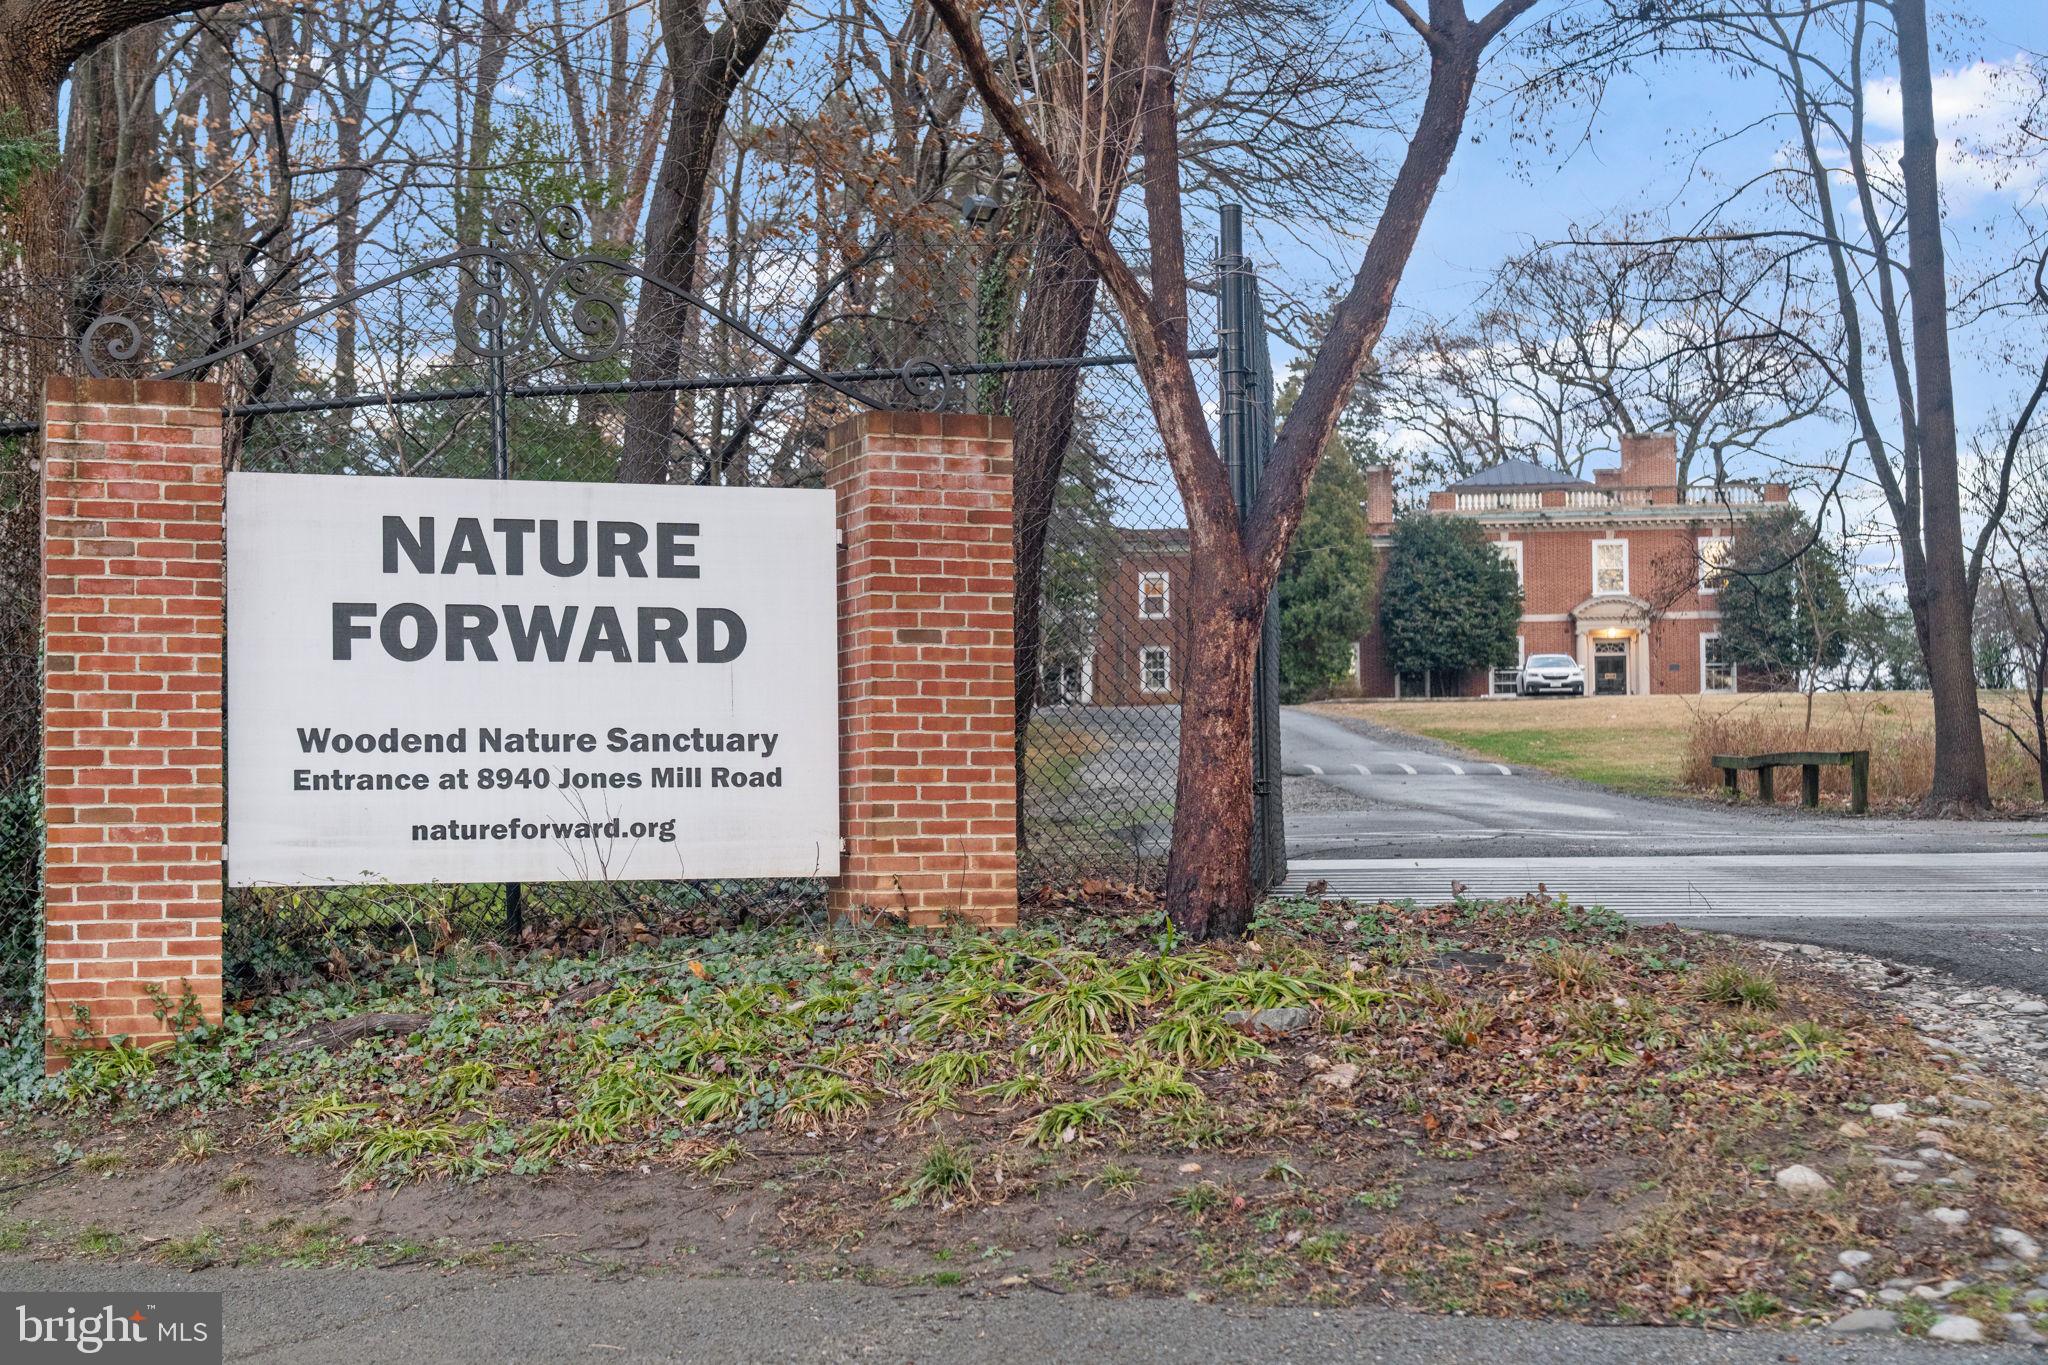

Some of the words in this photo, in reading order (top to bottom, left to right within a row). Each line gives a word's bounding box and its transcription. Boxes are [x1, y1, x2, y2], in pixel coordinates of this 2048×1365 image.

[382, 515, 701, 579] NATURE
[332, 602, 748, 664] FORWARD
[296, 727, 467, 754] Woodend
[479, 727, 597, 753] Nature
[606, 727, 779, 758] Sanctuary
[293, 769, 430, 791] Entrance
[438, 768, 469, 790] at
[477, 768, 550, 790] 8940
[558, 767, 643, 789] Jones
[651, 766, 702, 788] Mill
[711, 766, 782, 788] Road
[411, 818, 676, 843] natureforward.org
